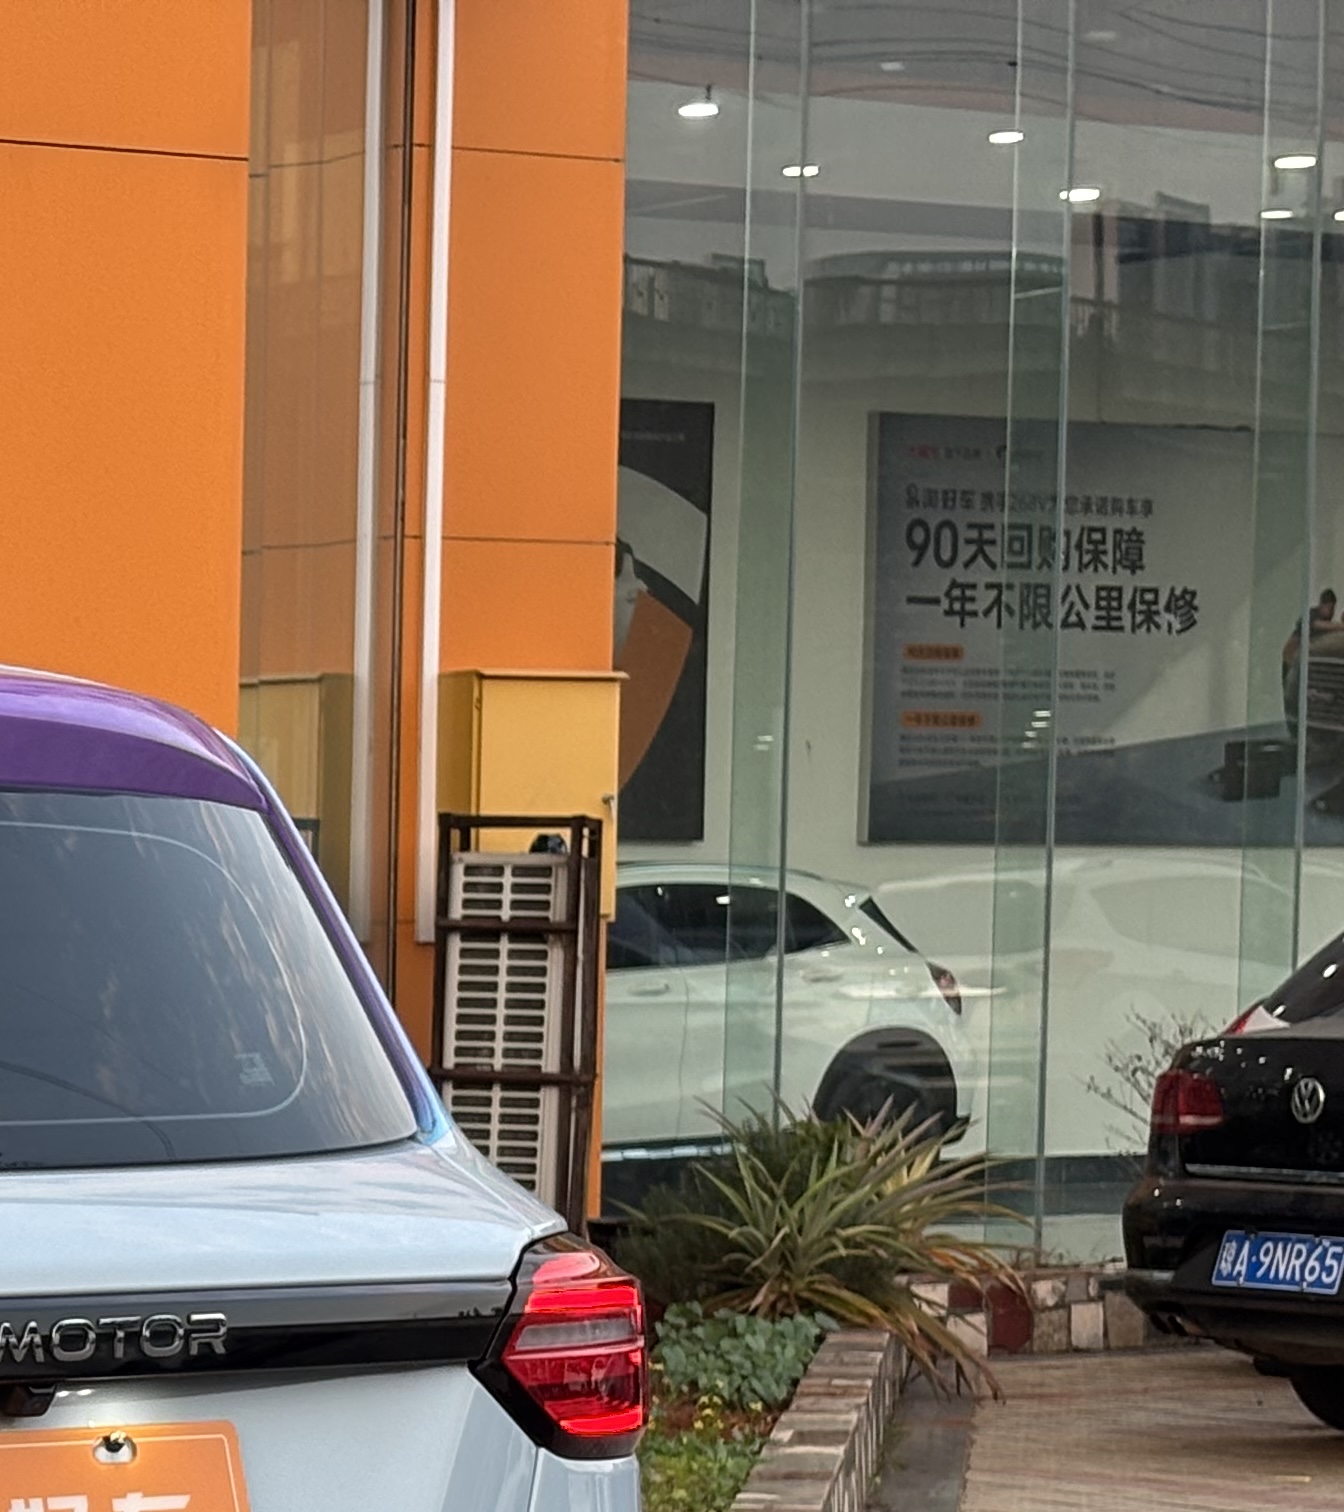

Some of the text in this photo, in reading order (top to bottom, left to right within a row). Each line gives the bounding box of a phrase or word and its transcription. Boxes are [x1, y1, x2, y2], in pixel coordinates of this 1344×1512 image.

[905, 518, 1146, 576] 90天回购保障
[905, 578, 1200, 636] 一年不限公里保修
